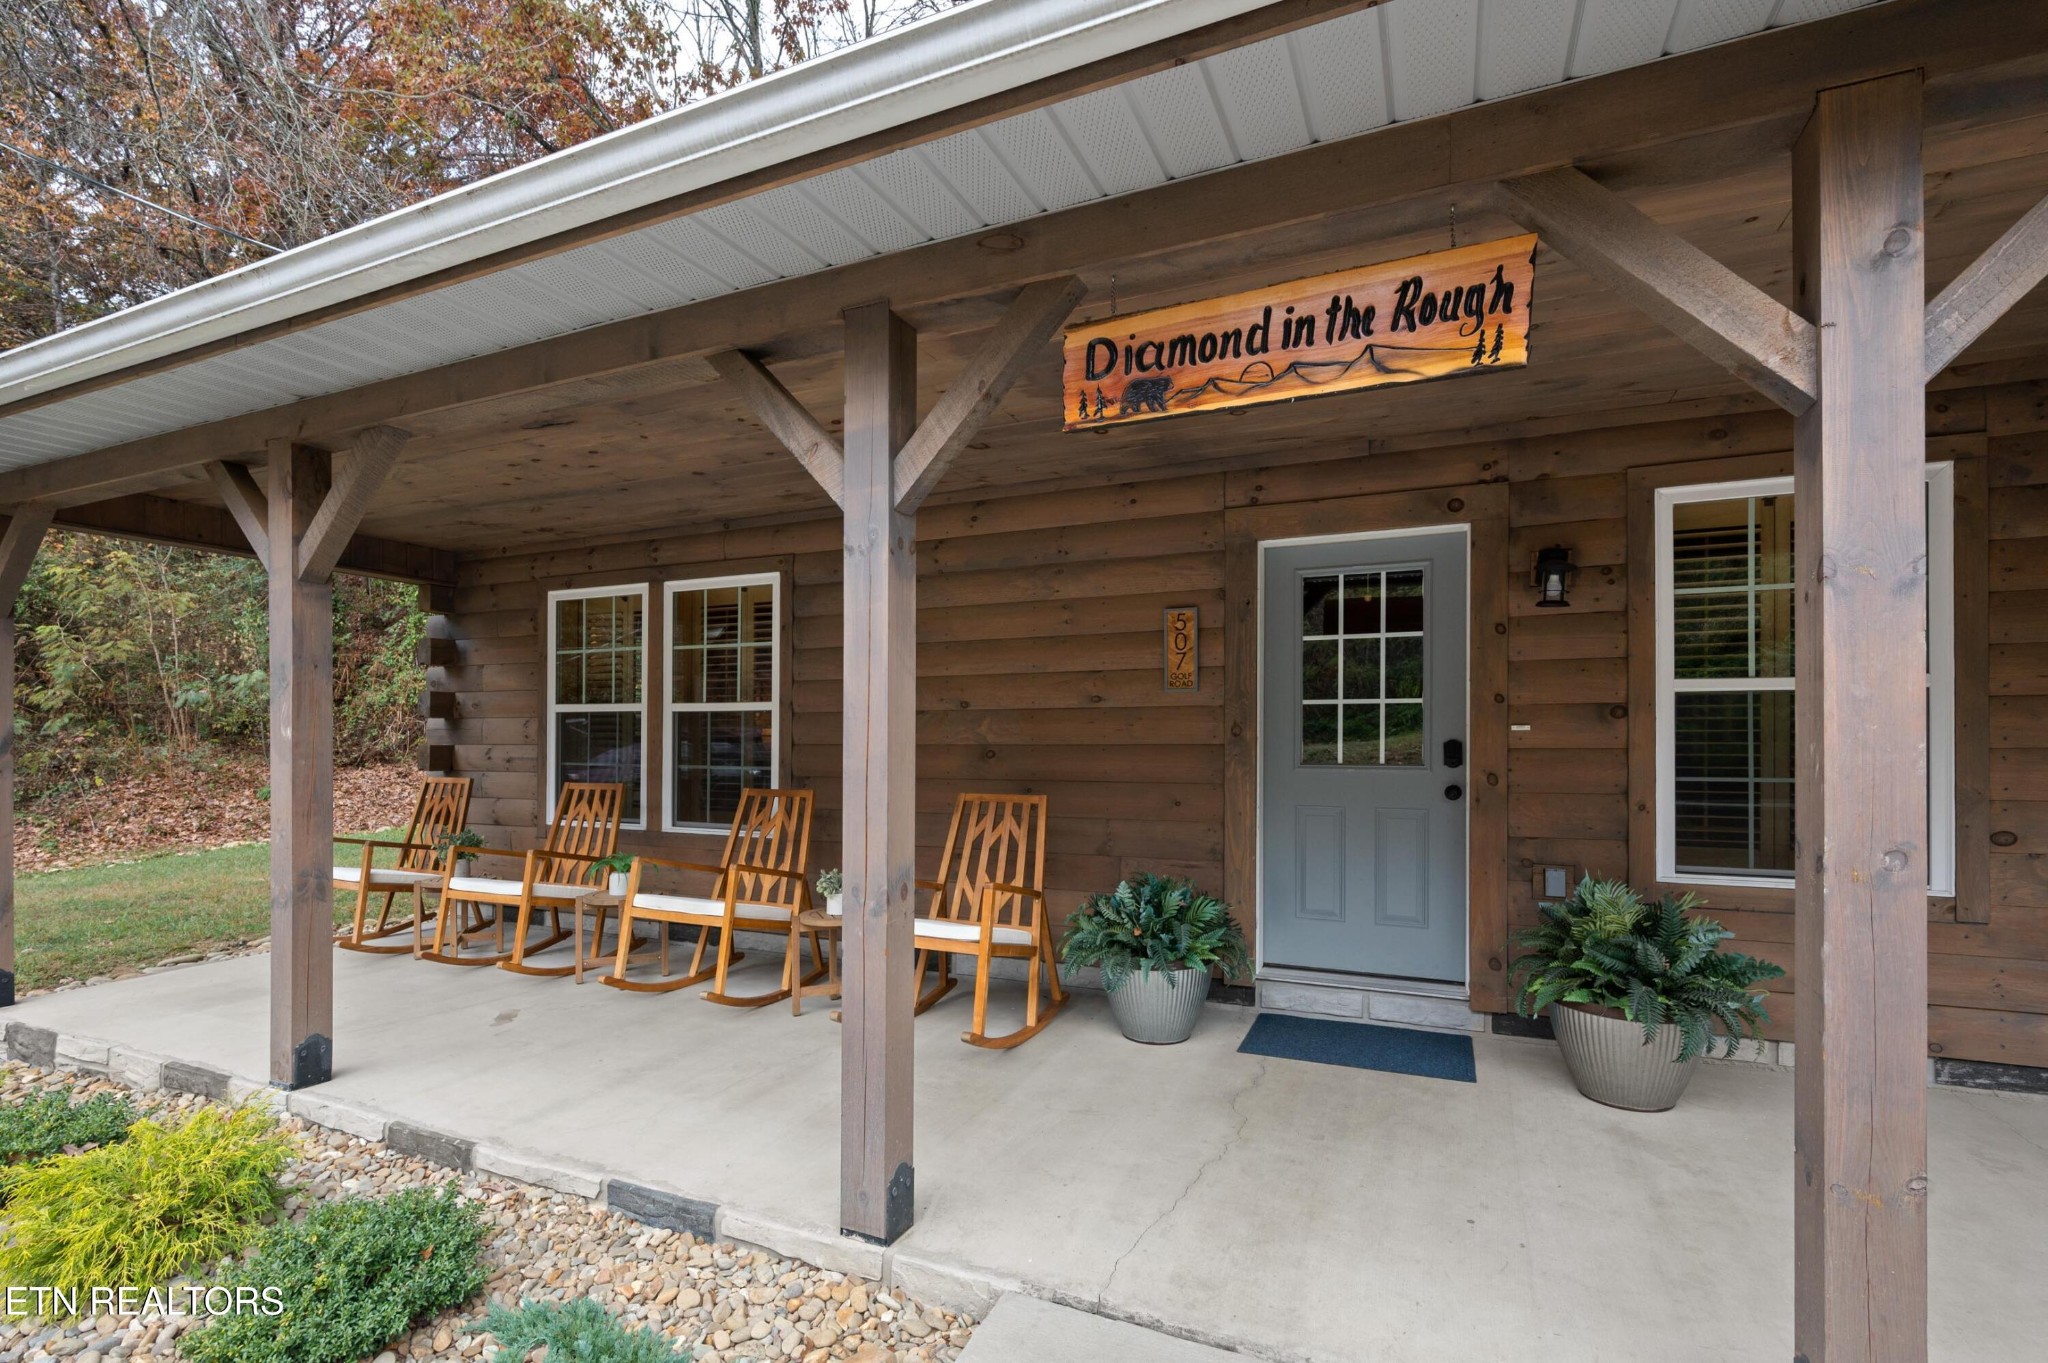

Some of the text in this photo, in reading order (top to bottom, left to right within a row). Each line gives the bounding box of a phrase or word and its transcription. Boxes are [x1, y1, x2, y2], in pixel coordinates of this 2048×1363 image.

[1085, 264, 1515, 381] Diamond in the Rough
[1174, 612, 1187, 671] 507
[1169, 680, 1194, 688] ROAD
[1170, 672, 1192, 680] GOLF
